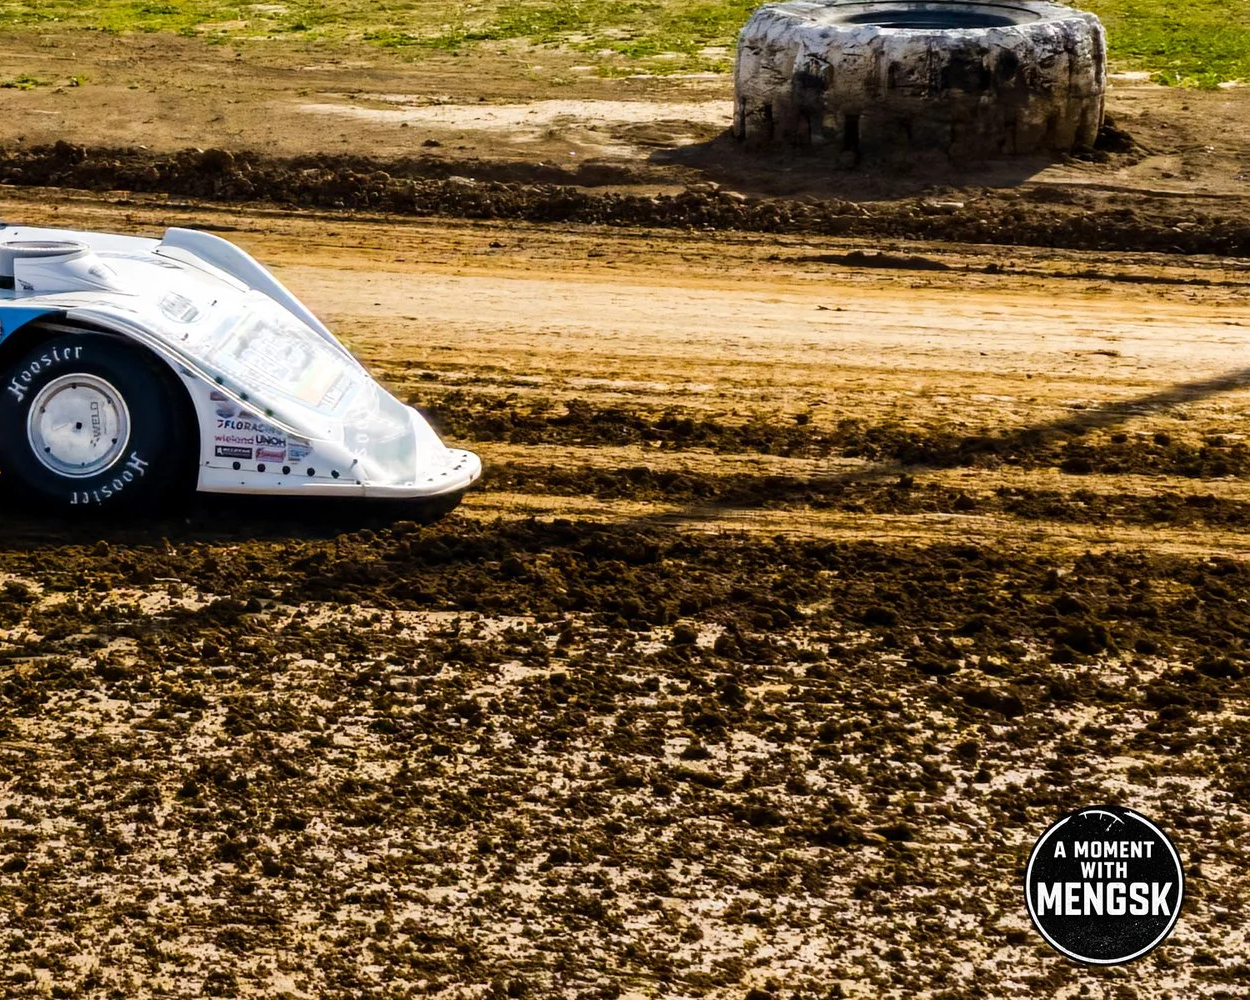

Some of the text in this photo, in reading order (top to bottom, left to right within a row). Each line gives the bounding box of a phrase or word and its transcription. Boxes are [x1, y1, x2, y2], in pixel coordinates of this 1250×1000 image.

[7, 346, 83, 402] Hoosier
[91, 401, 101, 438] WELD
[69, 451, 149, 506] Hoosier
